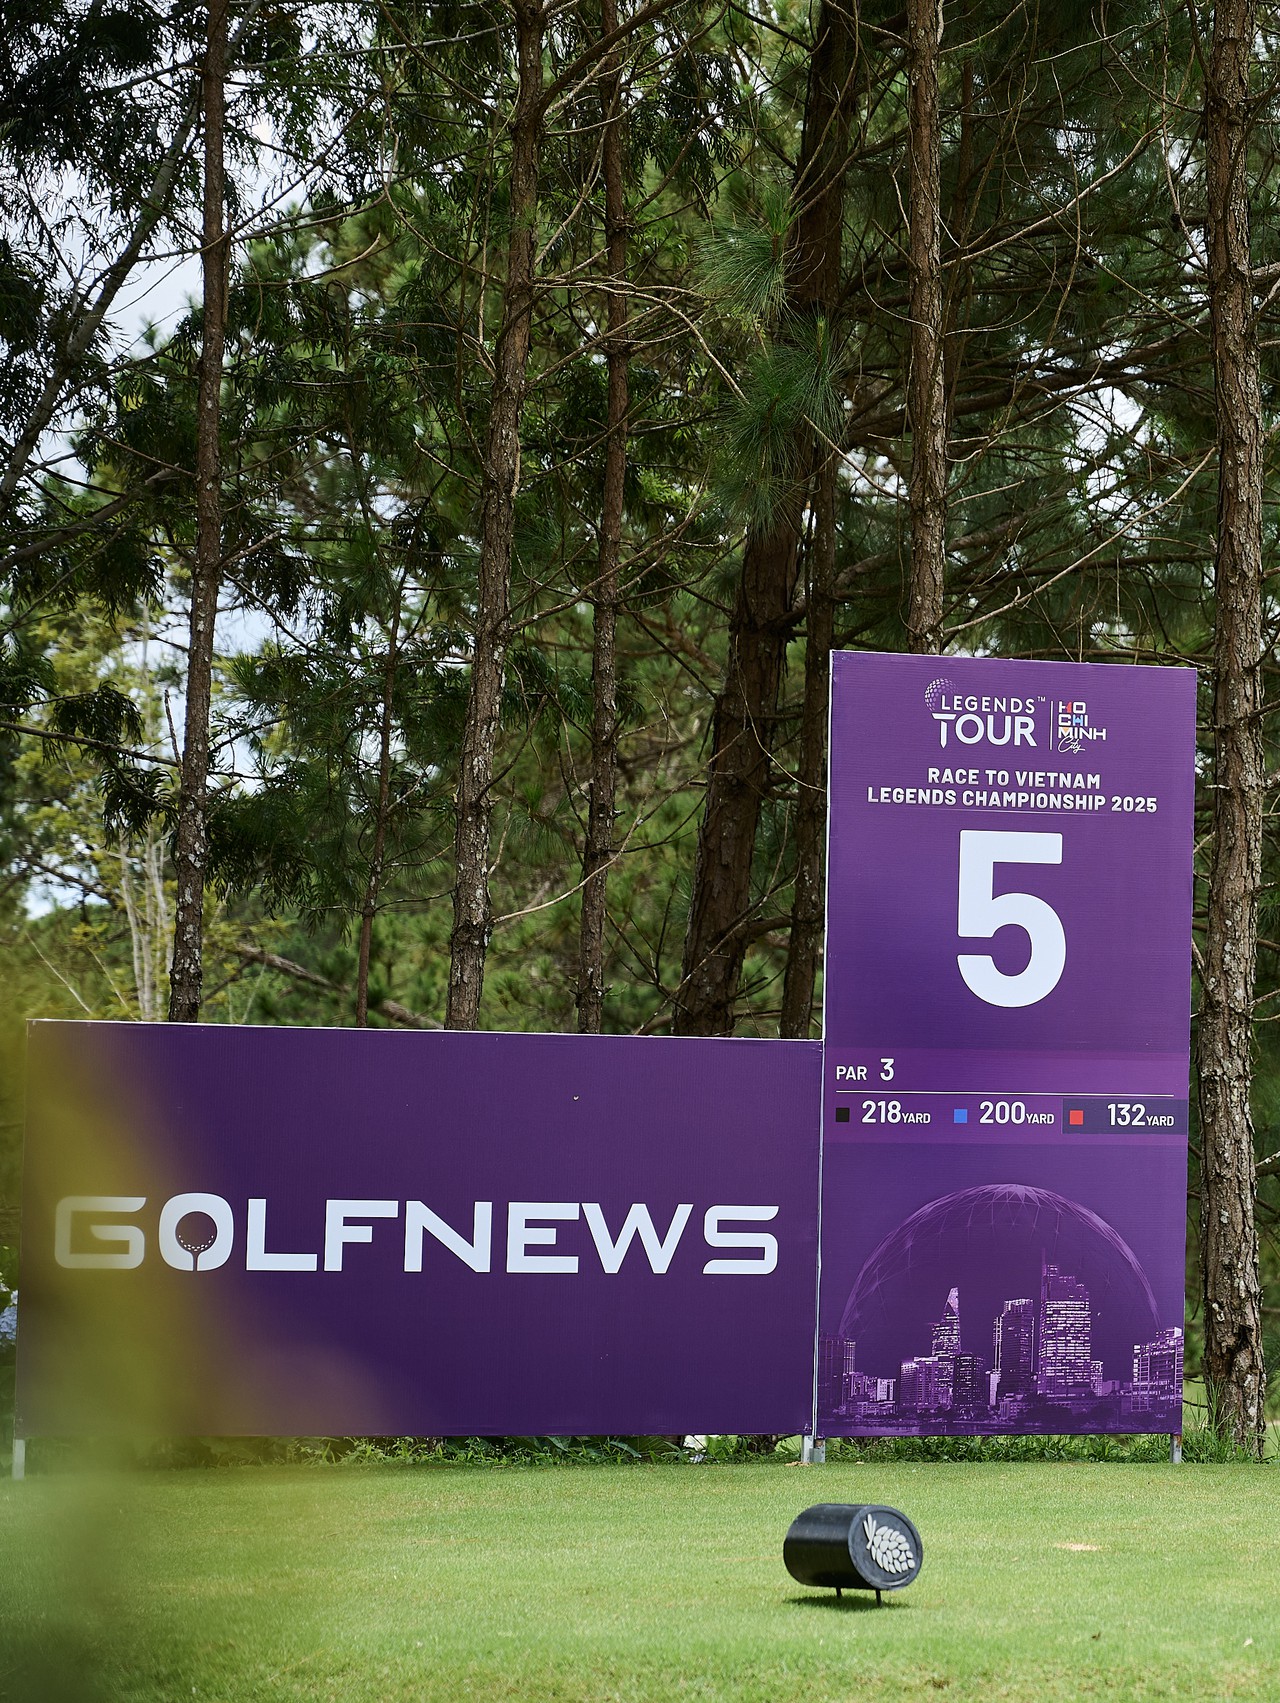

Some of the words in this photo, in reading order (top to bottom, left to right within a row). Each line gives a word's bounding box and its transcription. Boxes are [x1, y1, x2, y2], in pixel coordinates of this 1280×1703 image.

[941, 695, 1035, 714] LEGENDS
[931, 713, 1037, 749] TOUR
[1058, 713, 1089, 727] CHI
[1058, 726, 1107, 740] MINH
[1058, 737, 1086, 754] City
[928, 768, 979, 785] RACE
[984, 769, 1010, 786] TO
[1015, 771, 1101, 789] VIETNAM
[867, 786, 957, 806] LEGENDS
[962, 790, 1106, 811] CHAMPIONSHIP
[1111, 796, 1158, 813] 2025
[957, 829, 1067, 1008] 5
[836, 1066, 867, 1081] PAR
[880, 1058, 895, 1082] 3
[53, 1192, 779, 1275] GOLFNEWS
